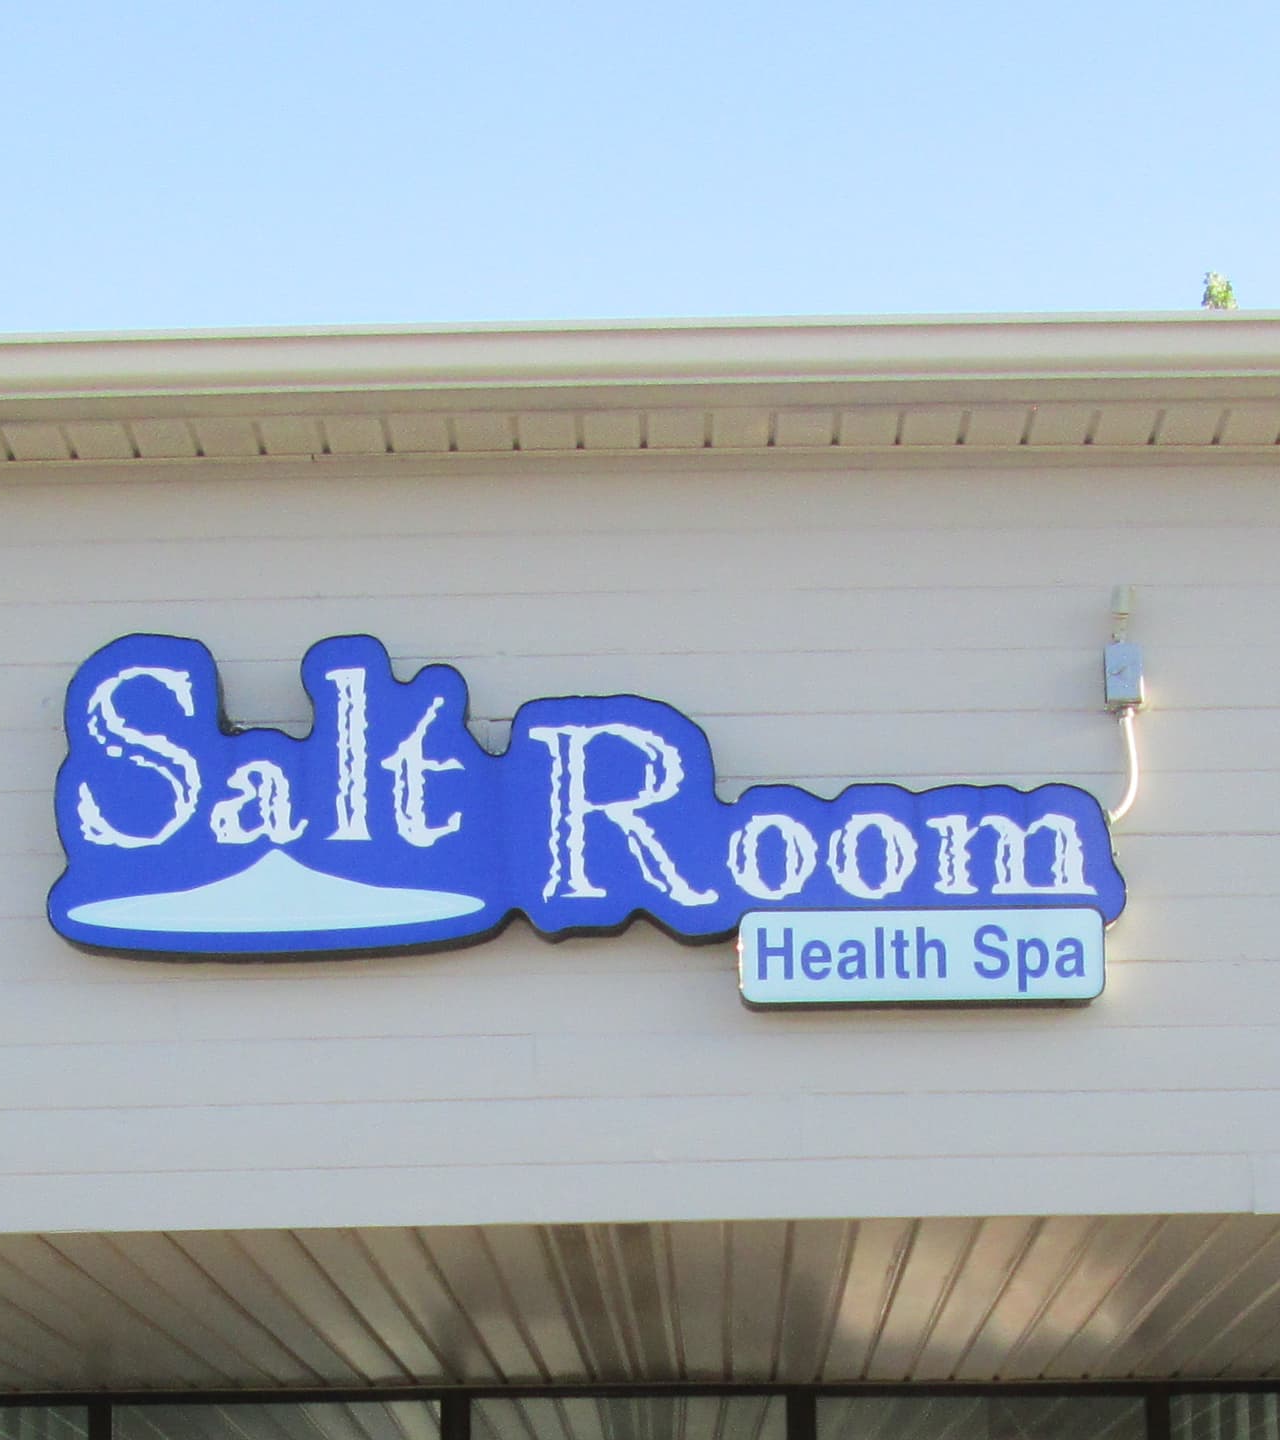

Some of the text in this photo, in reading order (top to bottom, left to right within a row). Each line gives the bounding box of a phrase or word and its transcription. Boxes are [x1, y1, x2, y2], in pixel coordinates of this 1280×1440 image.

[77, 665, 1099, 908] Salt Room
[756, 923, 1087, 993] Health Spa
